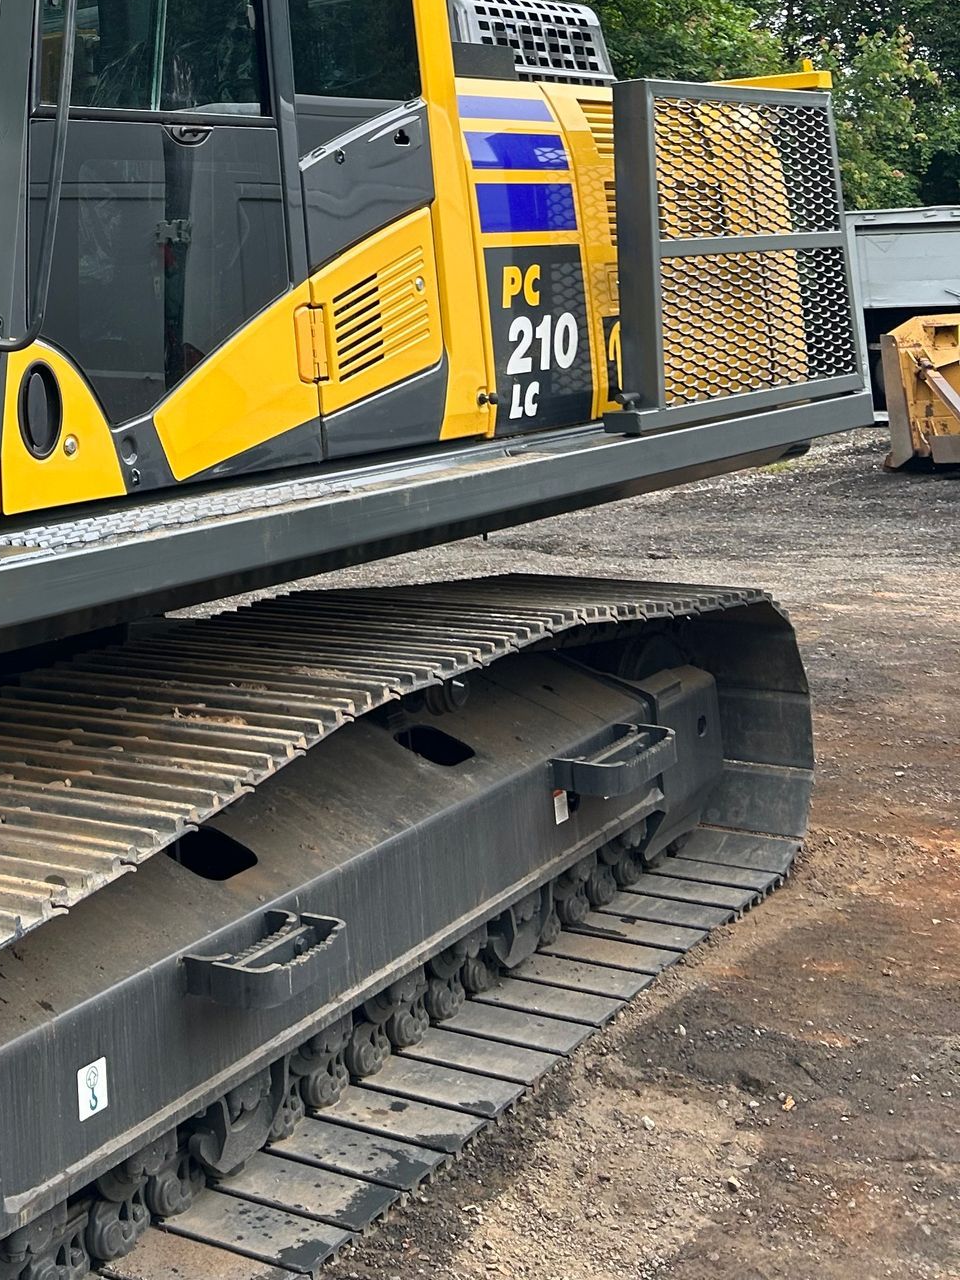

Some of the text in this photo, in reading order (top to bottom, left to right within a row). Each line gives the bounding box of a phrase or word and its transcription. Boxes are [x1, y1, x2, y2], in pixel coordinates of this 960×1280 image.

[502, 264, 540, 308] PC
[506, 312, 578, 375] 210
[509, 381, 540, 419] LC
